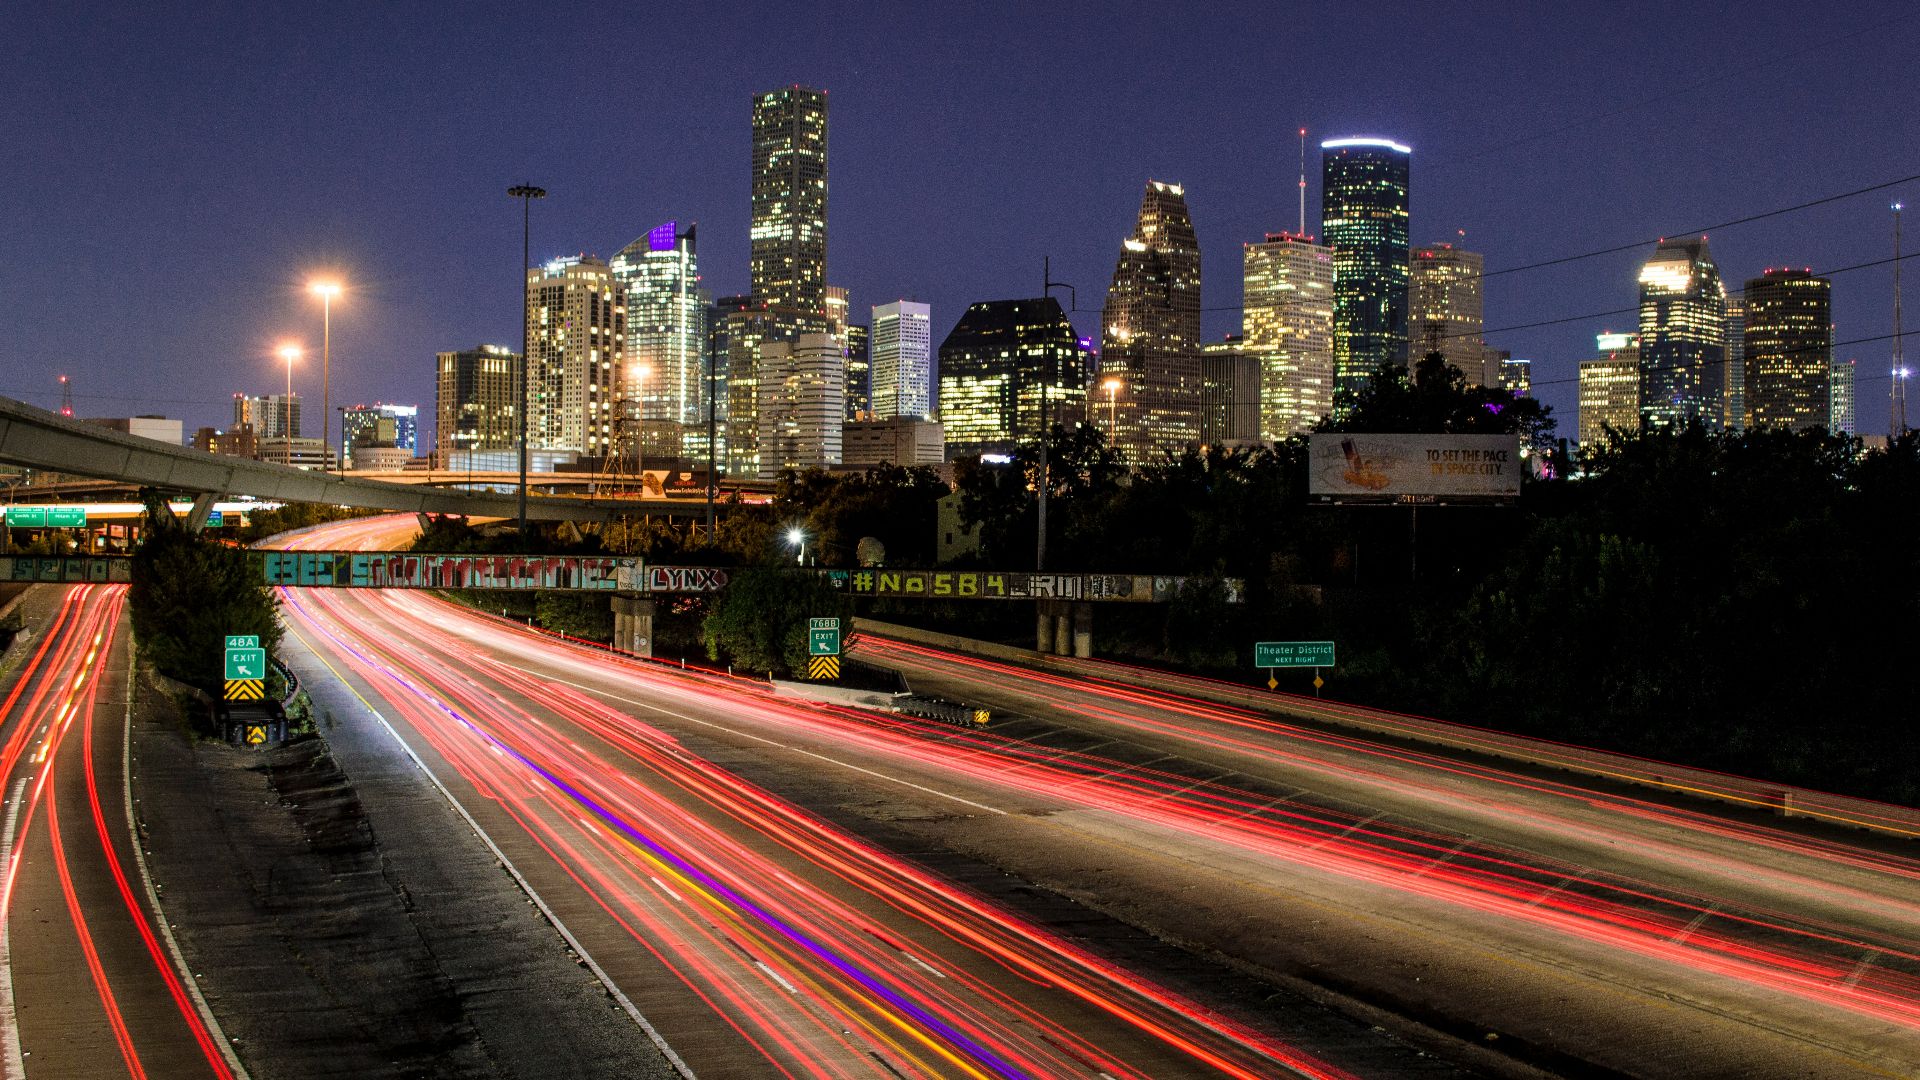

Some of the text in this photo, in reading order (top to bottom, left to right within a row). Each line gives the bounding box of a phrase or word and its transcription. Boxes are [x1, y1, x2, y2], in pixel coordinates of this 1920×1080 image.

[1426, 449, 1508, 462] TO SET THE PACE
[1447, 463, 1477, 475] SPACE
[650, 567, 720, 591] LYNX
[229, 638, 255, 647] 48A
[1258, 646, 1332, 654] Theater District
[233, 654, 257, 662] EXIT
